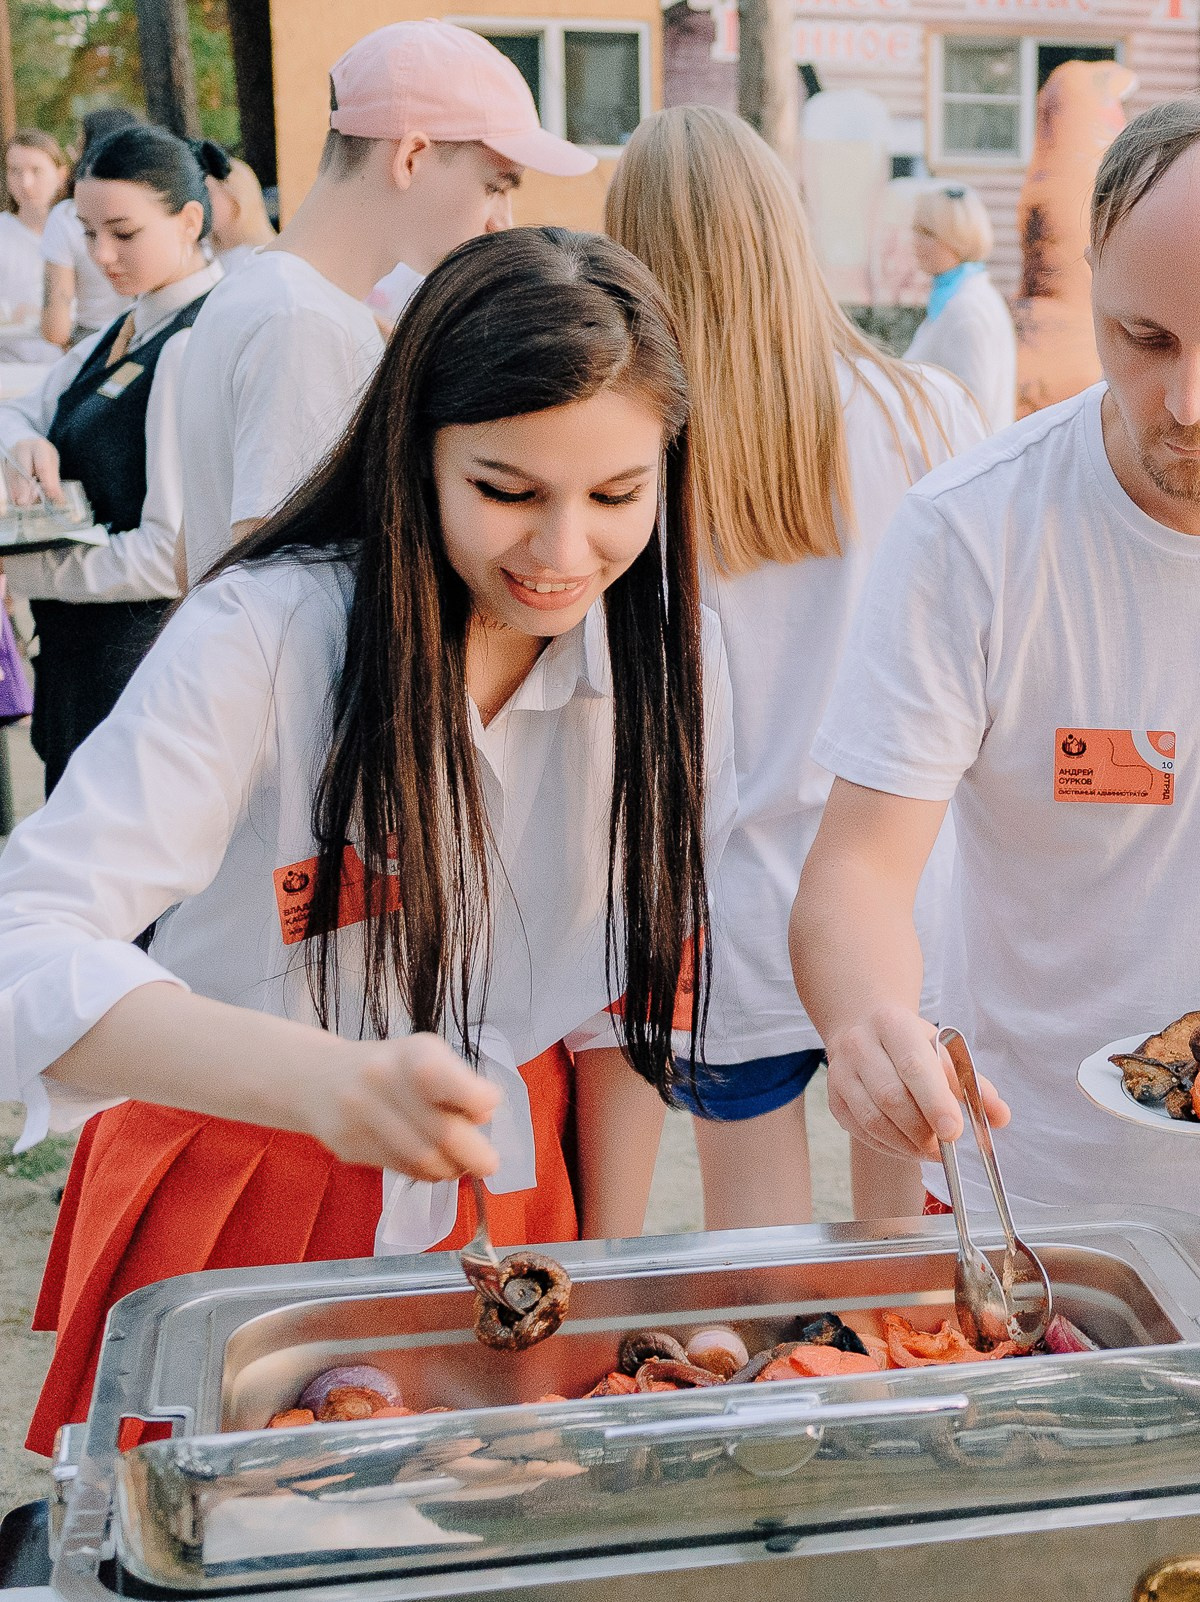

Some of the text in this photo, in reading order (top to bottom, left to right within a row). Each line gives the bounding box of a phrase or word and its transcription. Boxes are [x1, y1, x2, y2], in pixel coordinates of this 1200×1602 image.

[1161, 761, 1173, 769] 10
[1058, 768, 1093, 776] АНДРЕЙ
[1058, 777, 1092, 785] СУРКОВ
[283, 902, 311, 916] ВЛАД
